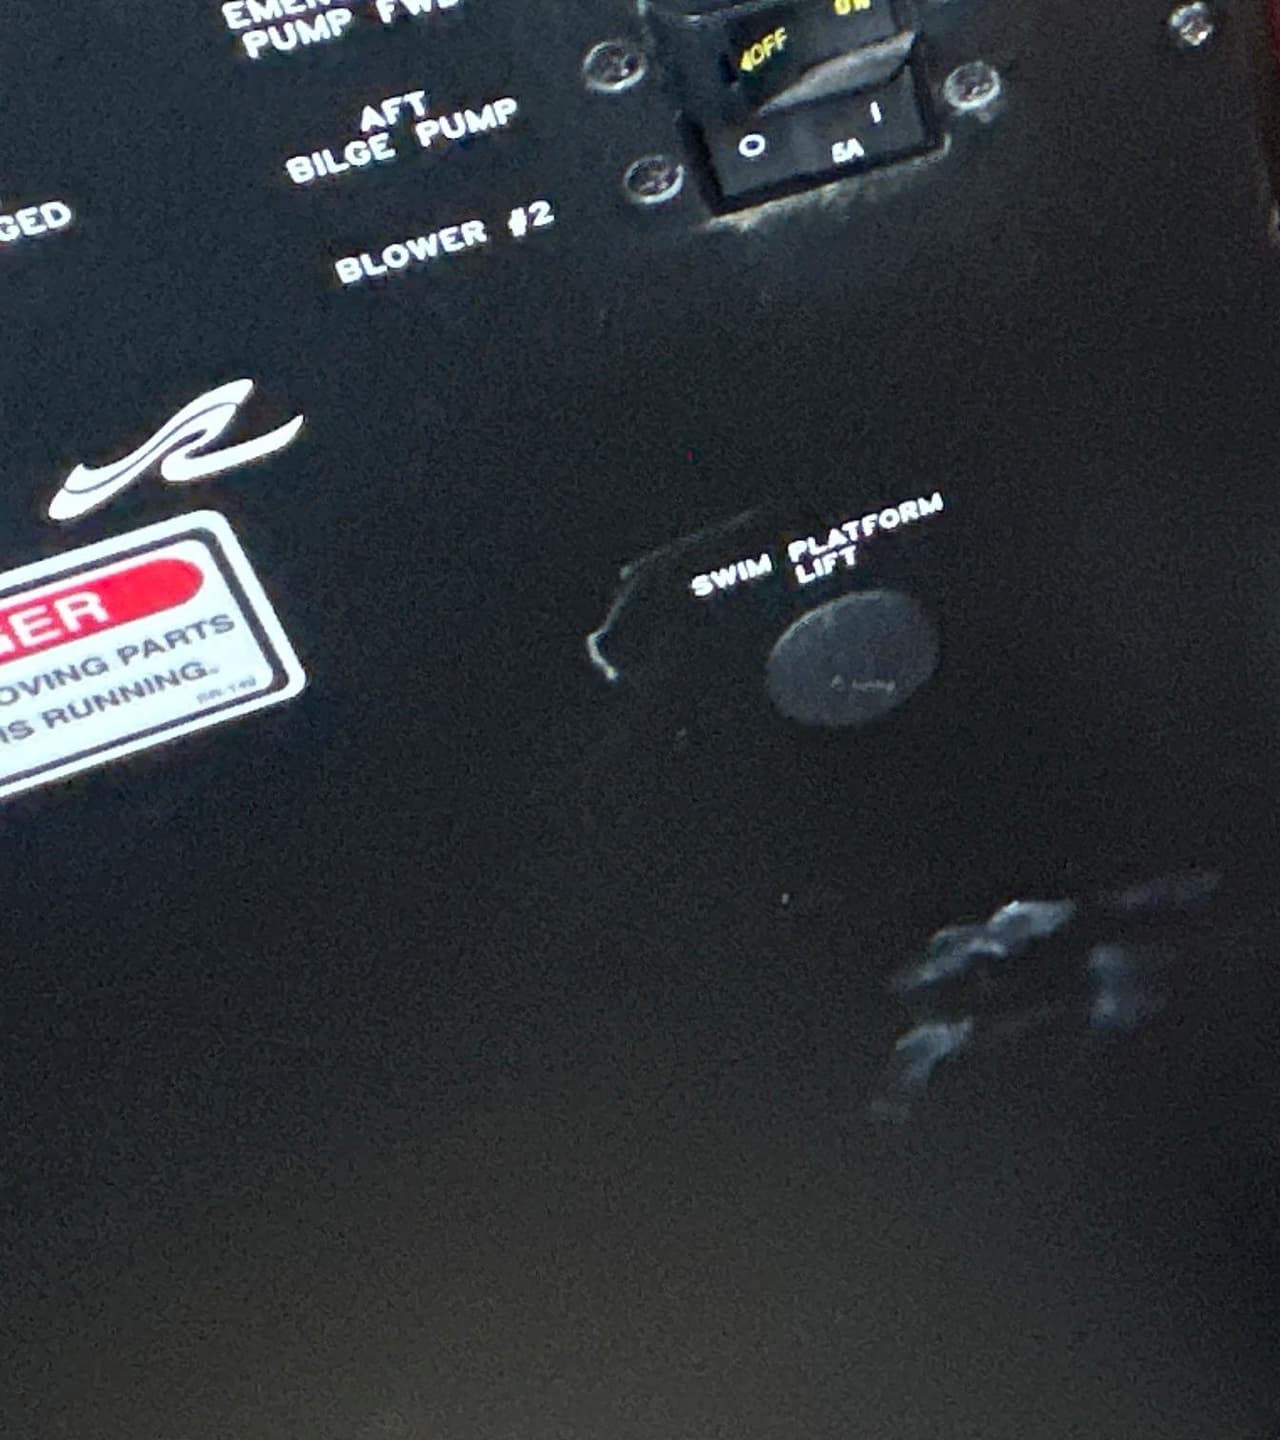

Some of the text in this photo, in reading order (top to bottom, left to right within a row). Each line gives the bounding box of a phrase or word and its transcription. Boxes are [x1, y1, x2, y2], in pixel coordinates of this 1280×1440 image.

[241, 8, 352, 59] PUMP
[285, 97, 517, 184] BILGE PUMP
[360, 90, 430, 140] AFT
[334, 200, 555, 284] BLOWER #2
[691, 492, 944, 596] SWIM PLATFORM
[791, 544, 857, 584] LIFT
[117, 613, 235, 665] PARTS
